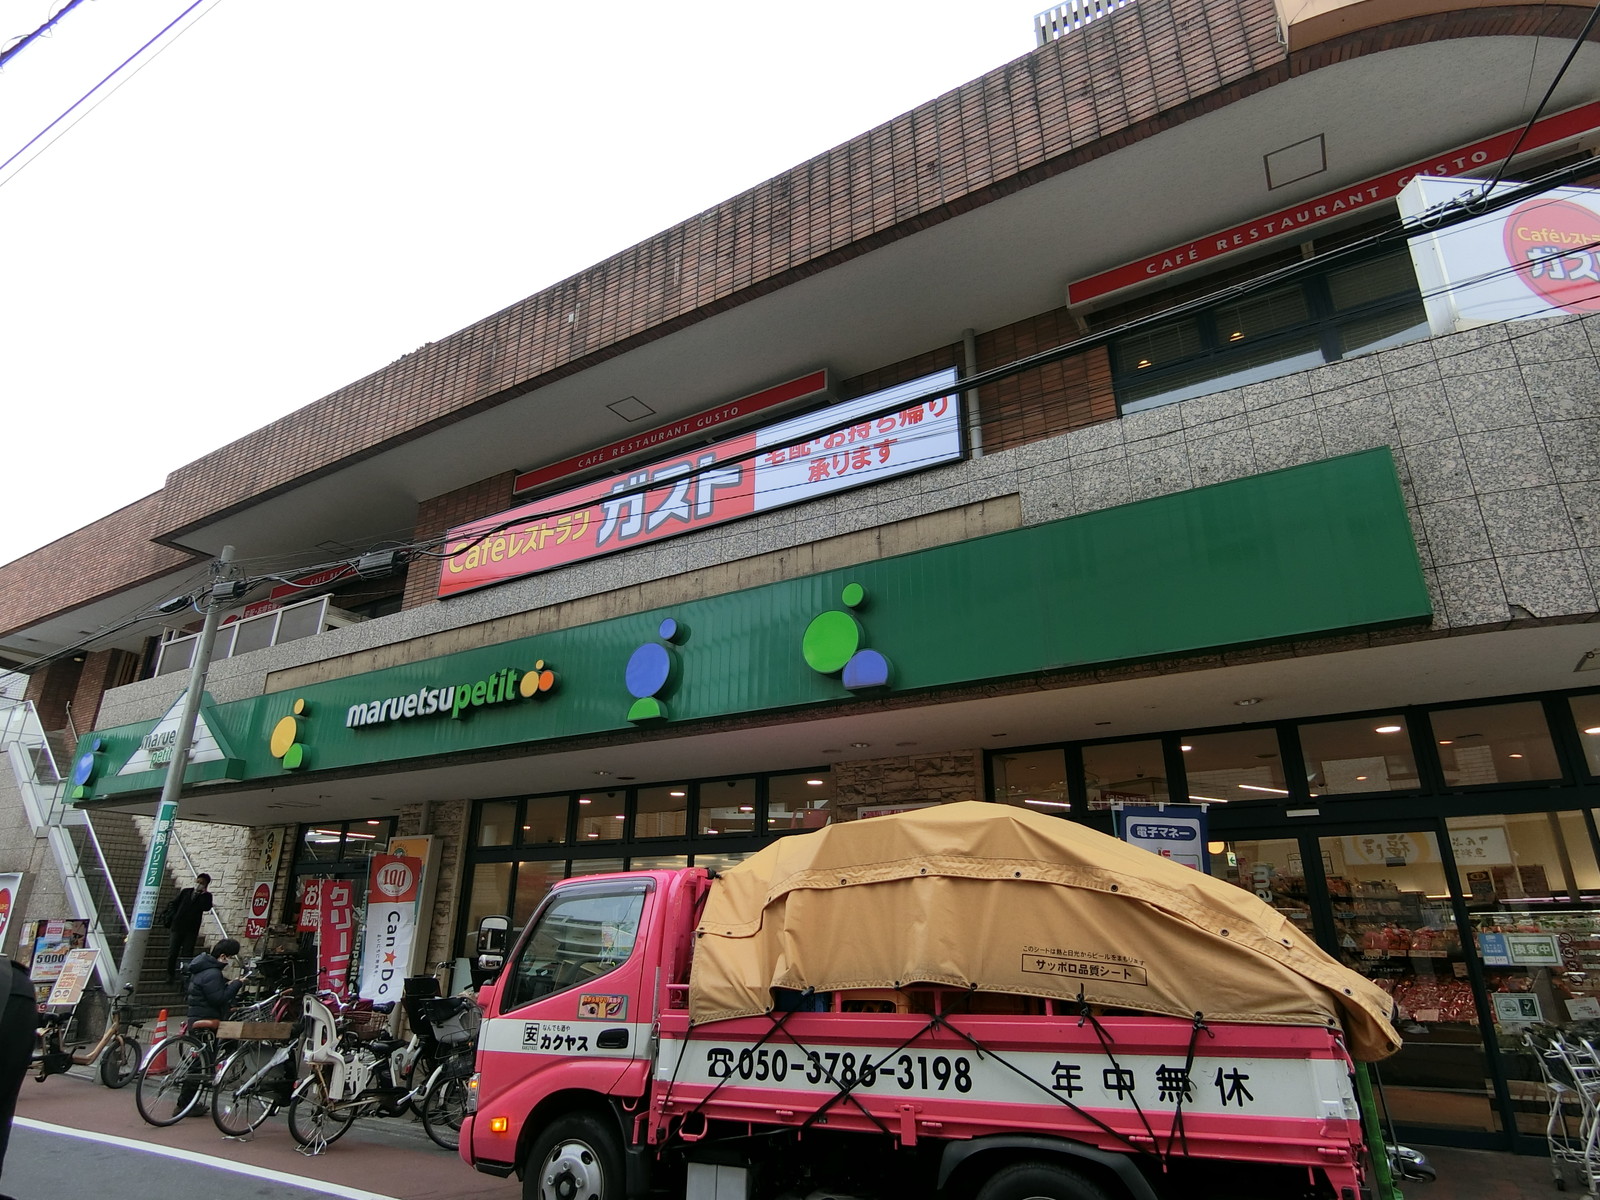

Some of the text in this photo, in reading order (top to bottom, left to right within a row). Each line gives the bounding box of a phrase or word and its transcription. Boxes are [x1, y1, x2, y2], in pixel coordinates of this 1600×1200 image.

[1146, 243, 1198, 274] CAFÉ
[1216, 186, 1380, 251] RESTAURANT
[578, 407, 739, 468] CAFÉ RESTAURANT GUSTO
[808, 438, 899, 482] 承ります
[596, 451, 744, 548] ガスト
[140, 730, 176, 749] marue
[1137, 826, 1191, 838] 電子マネー
[382, 868, 407, 887] 100
[1513, 942, 1551, 955] 換気中
[1035, 959, 1132, 980] サッポロ品質シート
[540, 1034, 588, 1052] カクヤス
[738, 1048, 973, 1094] 050-3786-3198
[1051, 1060, 1254, 1108] 年中無休
